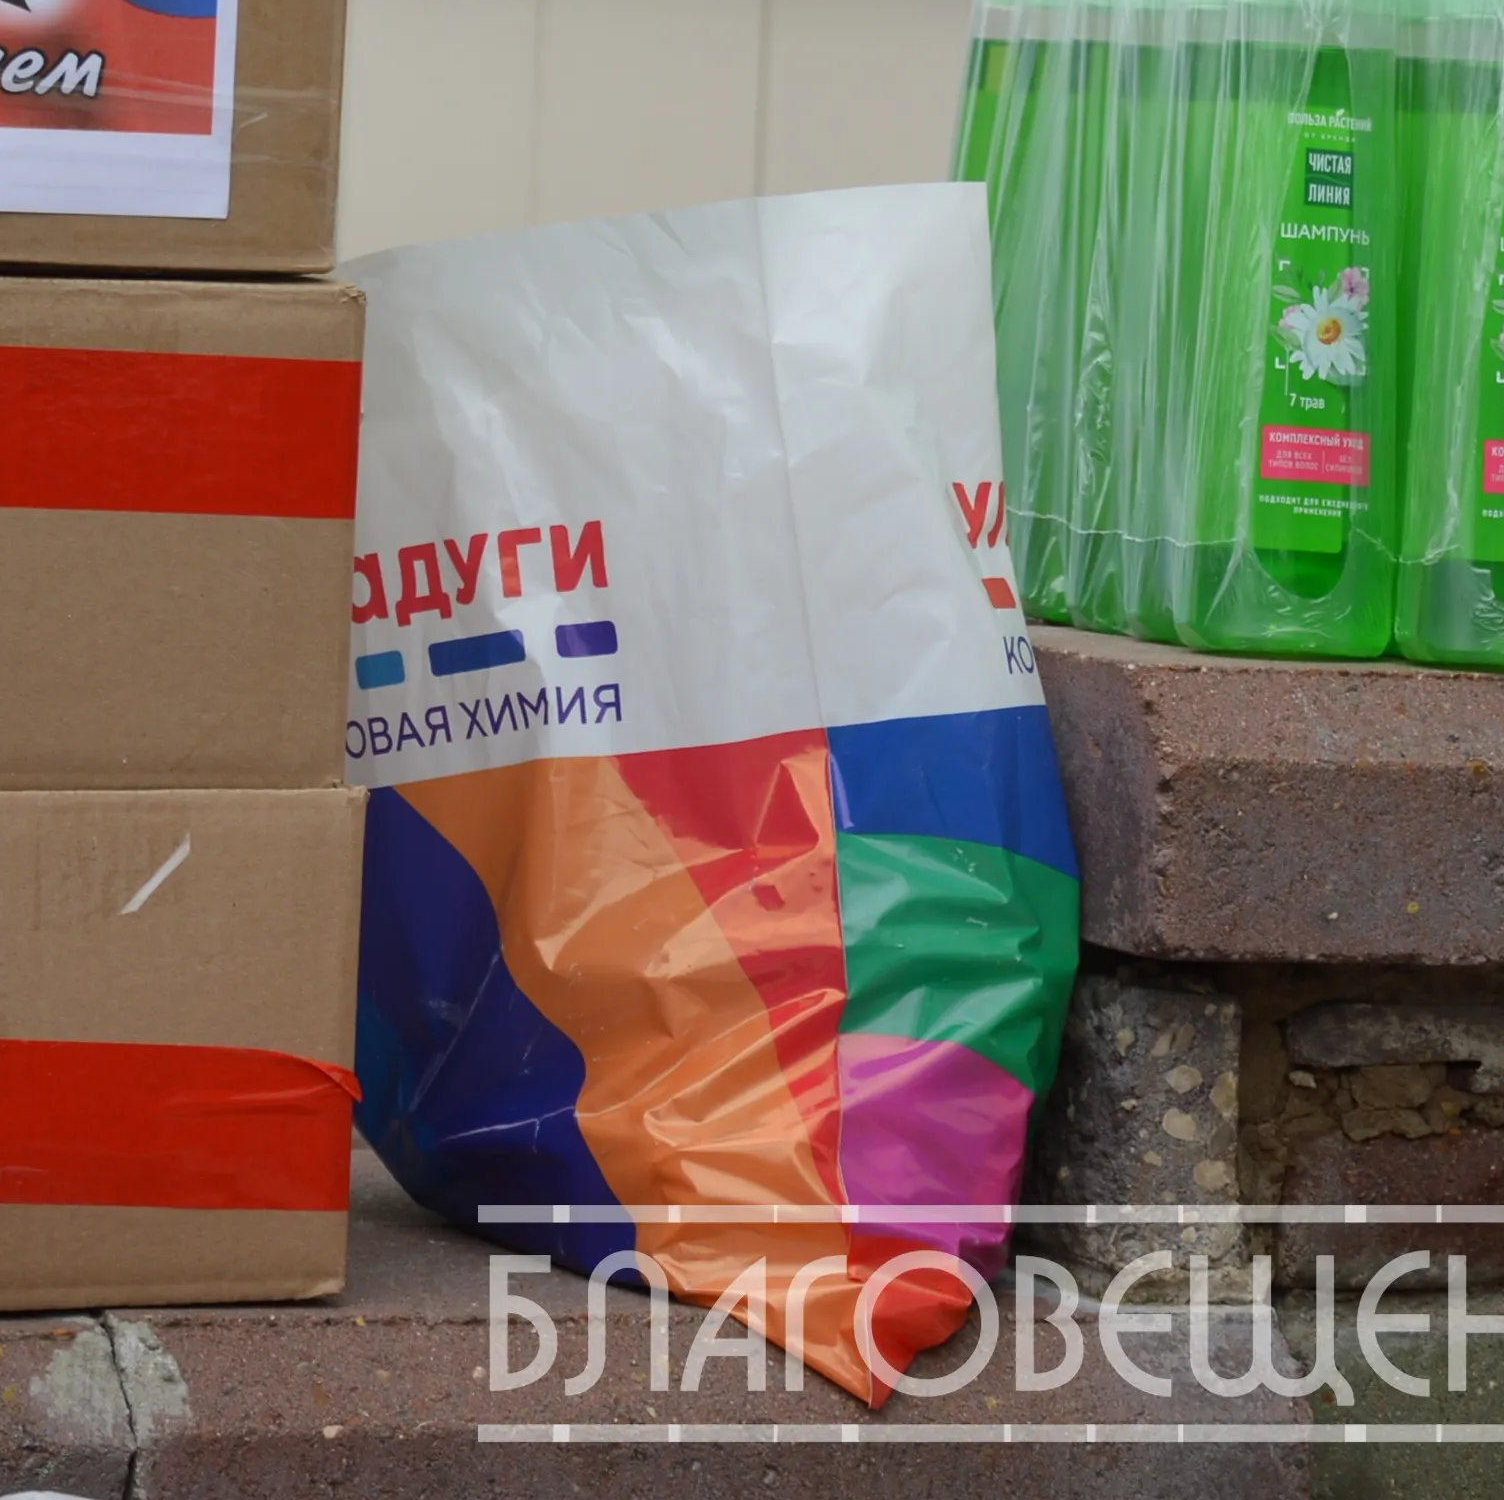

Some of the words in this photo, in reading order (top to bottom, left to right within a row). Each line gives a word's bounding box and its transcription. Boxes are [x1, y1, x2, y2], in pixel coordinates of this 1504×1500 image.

[1308, 153, 1352, 175] ЧИСТАЯ
[1308, 184, 1350, 205] ЛИНИЯ
[1280, 223, 1370, 246] ШАМПУНЬ
[1289, 393, 1297, 407] 7
[1300, 397, 1325, 411] трав
[1269, 432, 1340, 448] КОМПЛЕКСНЫЙ
[1003, 636, 1035, 674] КО
[345, 705, 452, 760] ОВАЯ
[458, 683, 623, 740] ХИМИЯ
